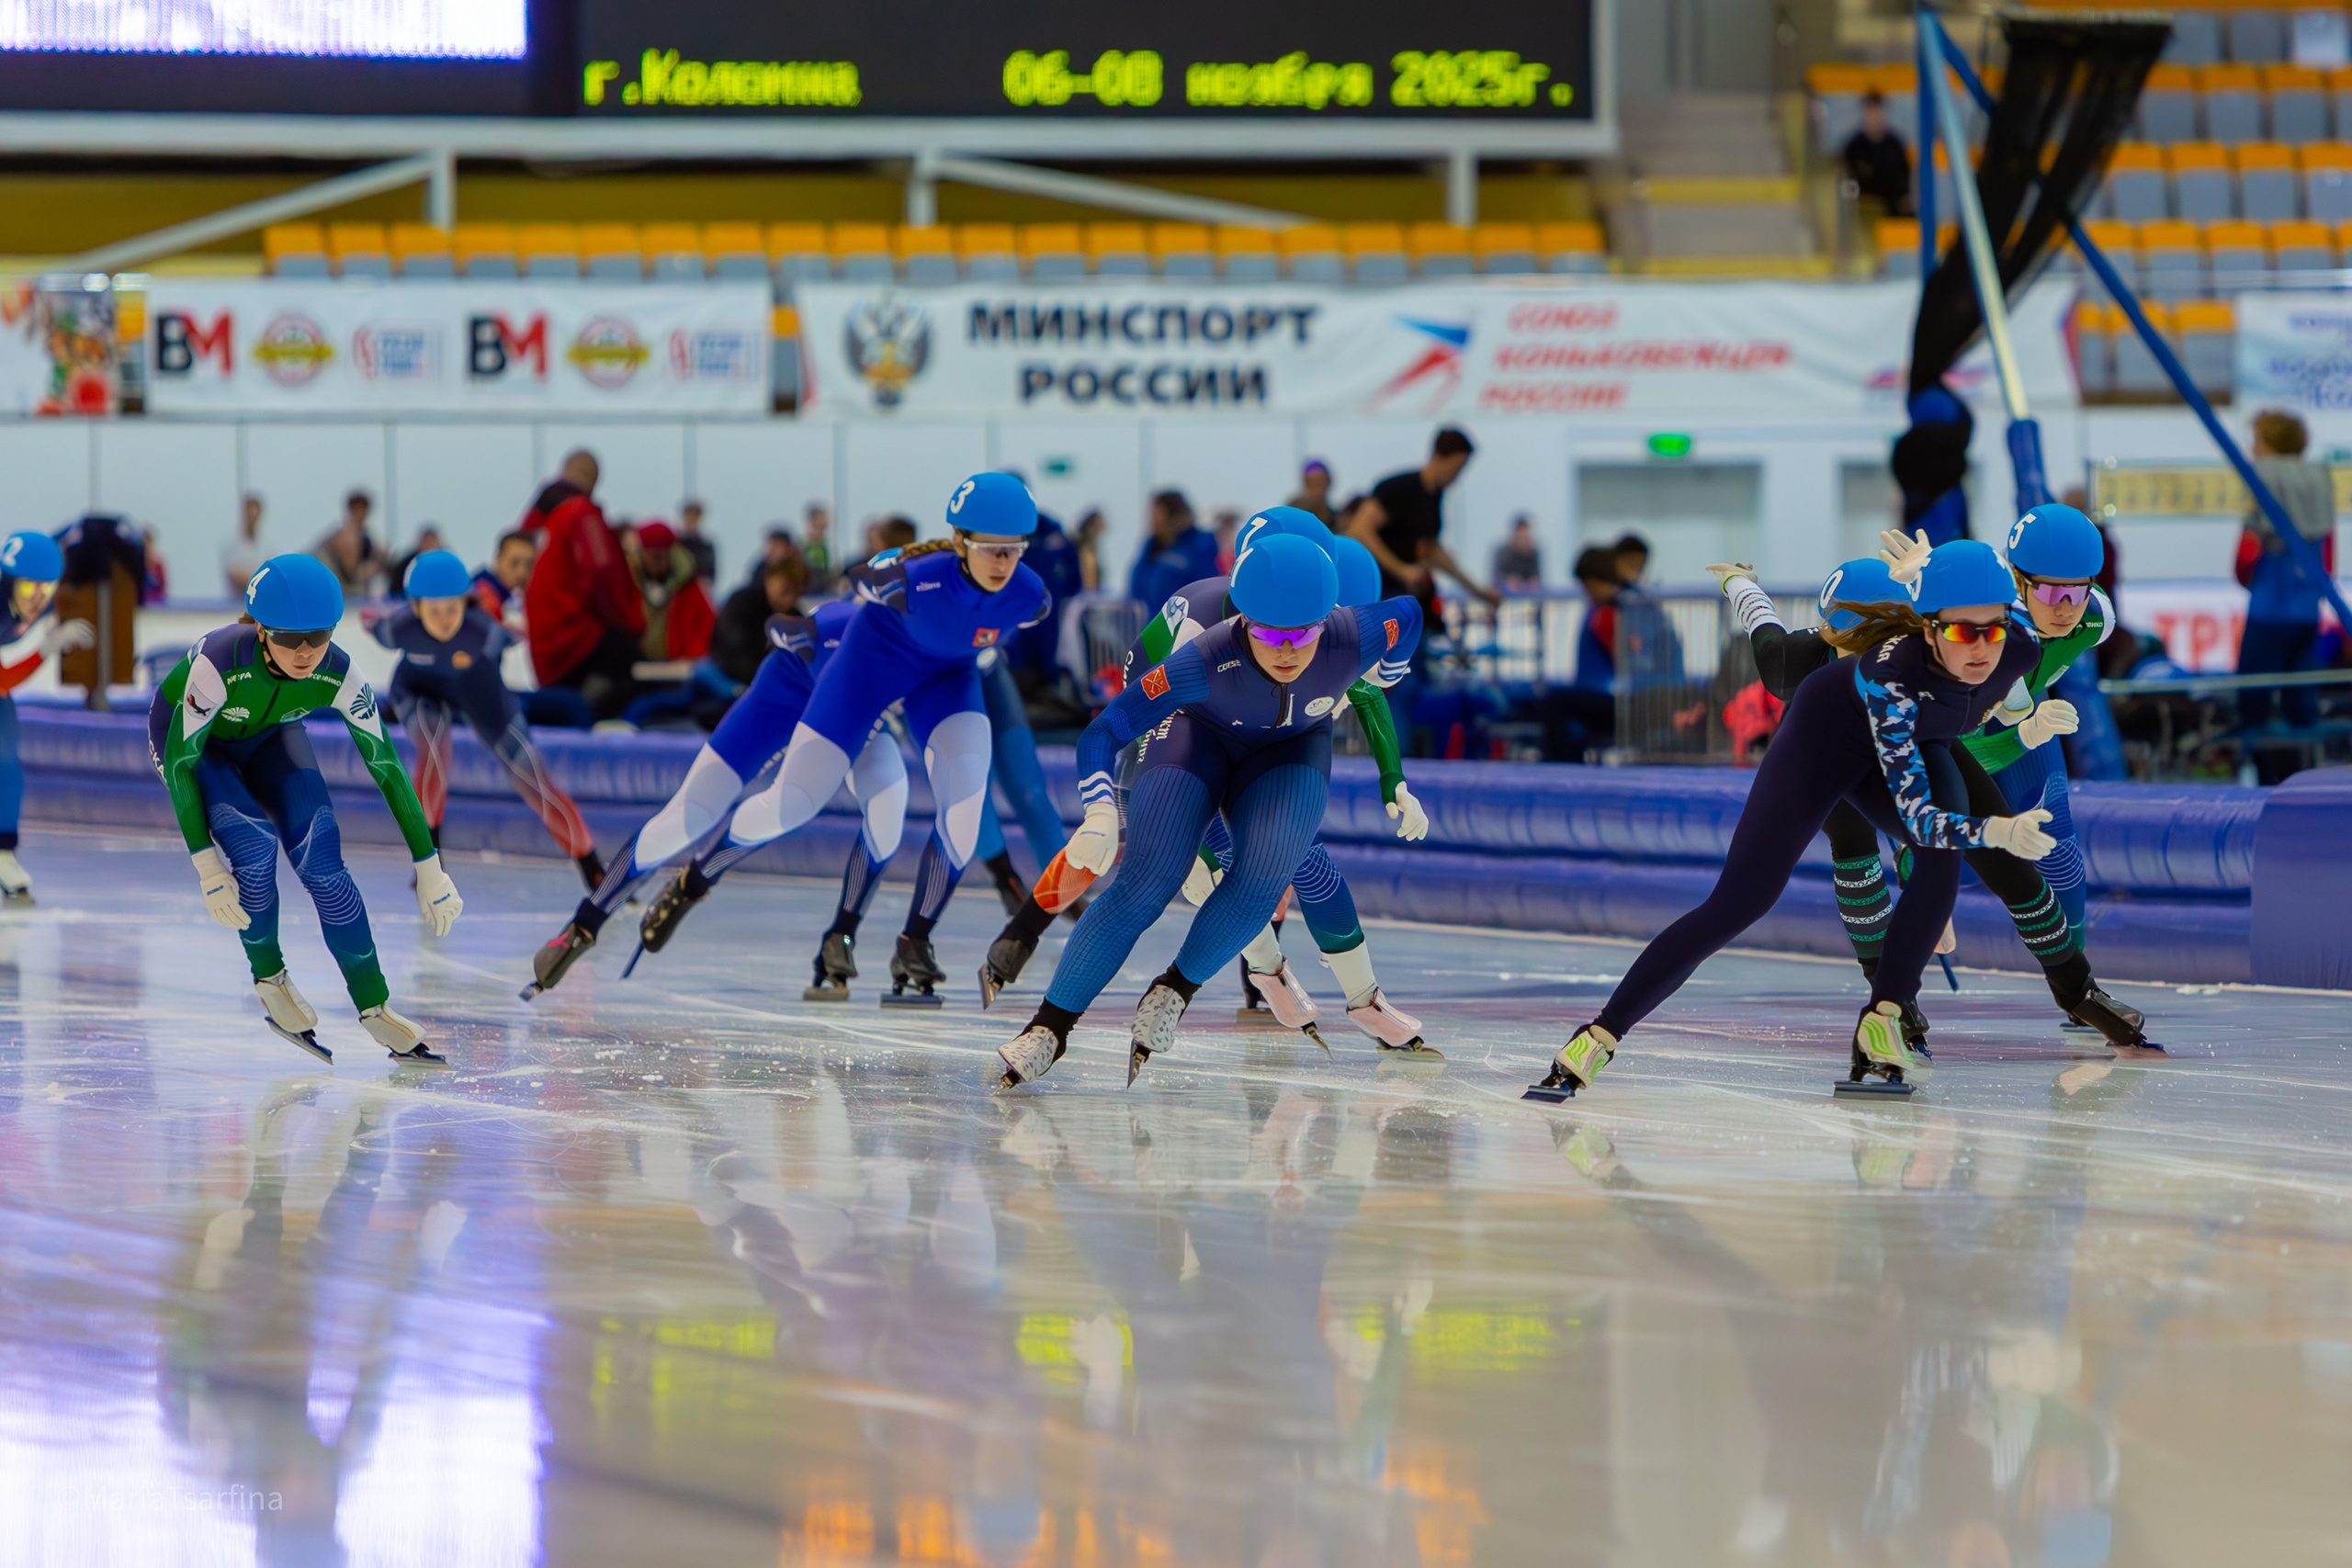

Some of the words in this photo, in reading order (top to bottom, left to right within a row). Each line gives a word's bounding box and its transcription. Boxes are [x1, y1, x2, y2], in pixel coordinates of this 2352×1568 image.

[969, 303, 1320, 346] МИНСПОРТ
[1018, 366, 1267, 404] РОССИИ
[950, 479, 976, 513] 3
[2009, 513, 2037, 549] 5
[246, 567, 271, 605] 4
